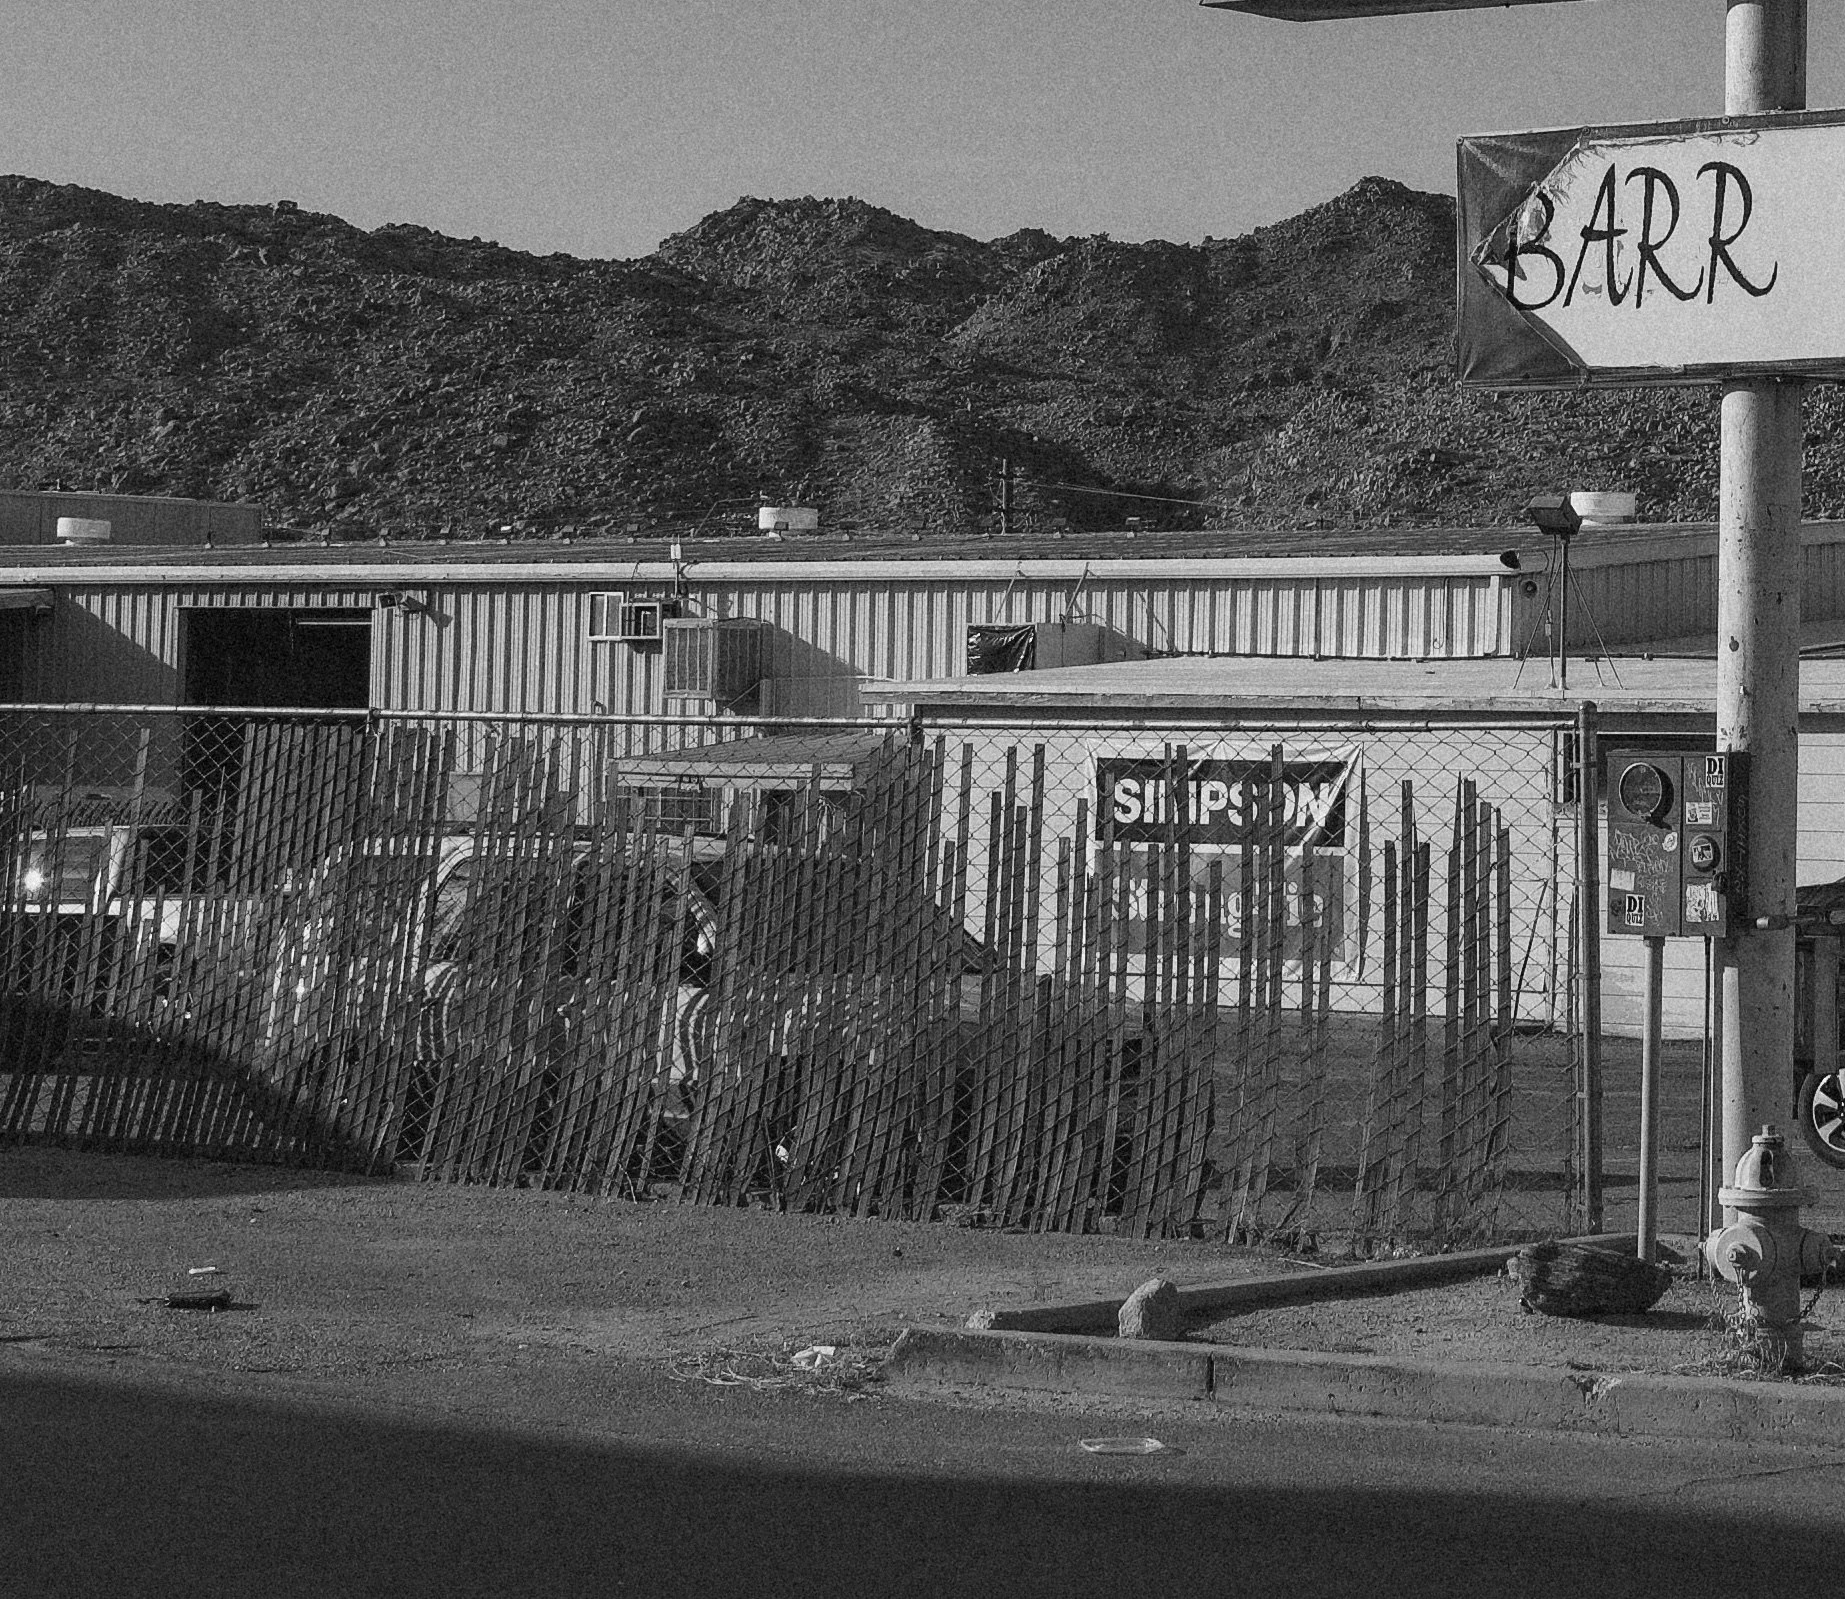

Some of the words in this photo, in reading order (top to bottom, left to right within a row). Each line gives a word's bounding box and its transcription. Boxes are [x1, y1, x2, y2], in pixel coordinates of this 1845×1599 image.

[1504, 160, 1778, 311] BARR
[1706, 757, 1724, 775] DI
[1626, 895, 1644, 913] DI
